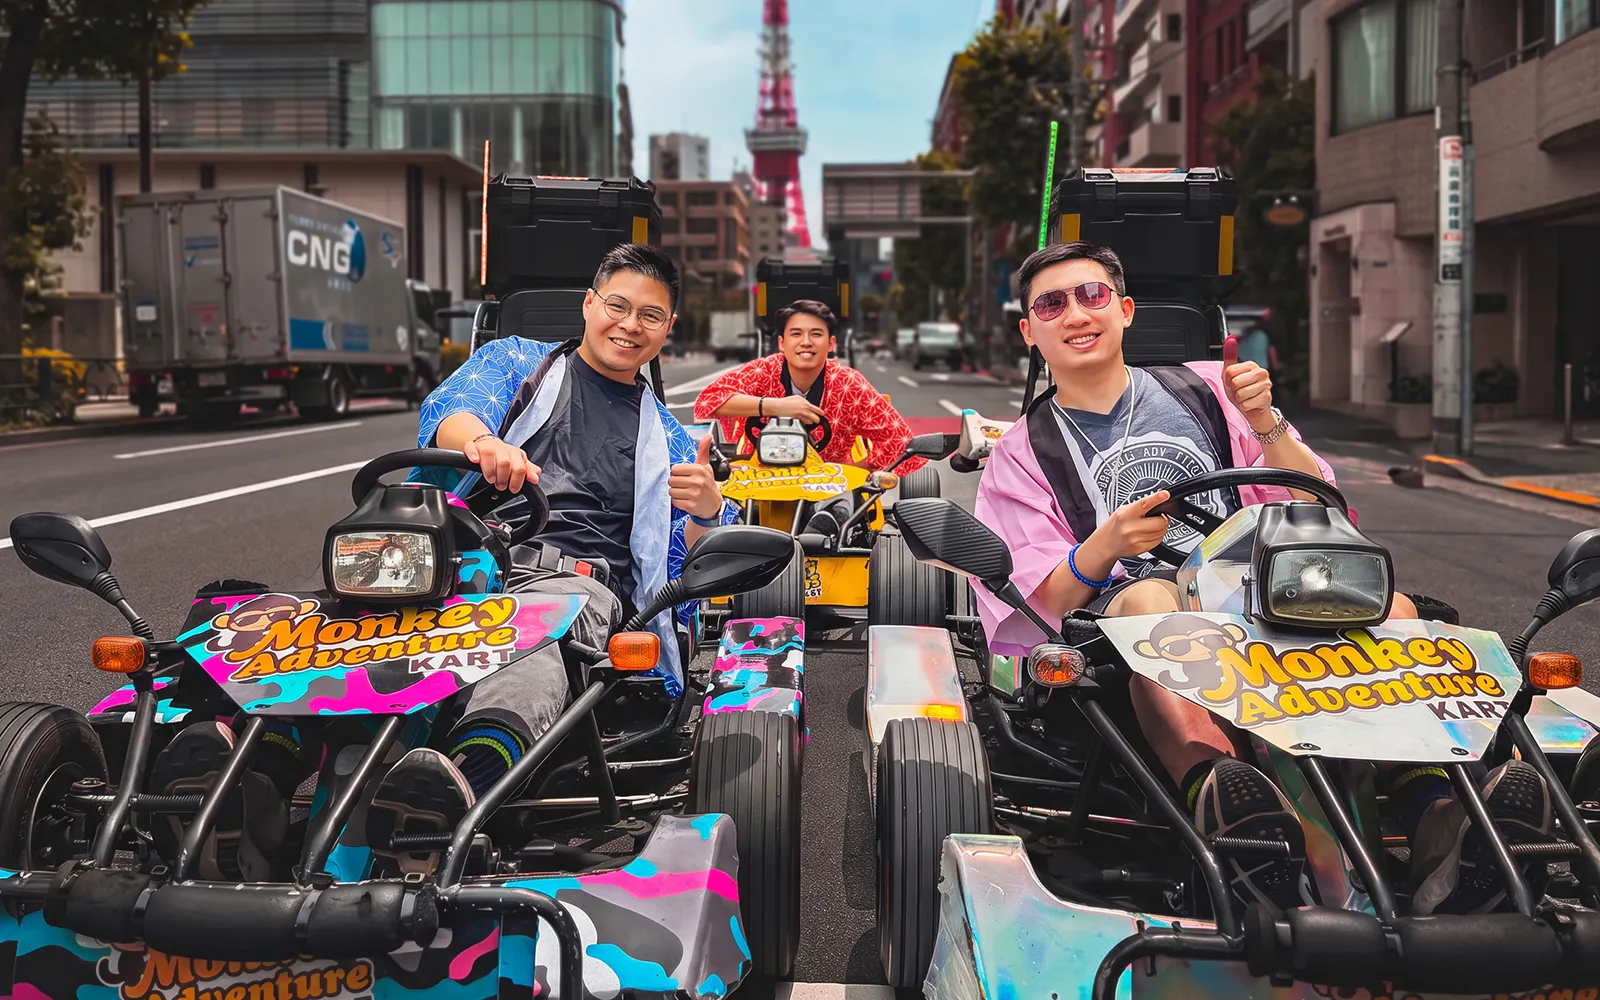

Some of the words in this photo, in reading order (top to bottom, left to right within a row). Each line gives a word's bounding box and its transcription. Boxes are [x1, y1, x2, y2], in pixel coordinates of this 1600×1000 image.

[287, 229, 351, 275] CNG
[1143, 447, 1167, 457] ADV
[229, 596, 514, 663] Monkey
[236, 627, 514, 679] Adventure
[410, 647, 516, 673] KART
[1202, 628, 1476, 701] Monkey
[1239, 671, 1502, 725] Adventure
[147, 963, 370, 1000] dventure
